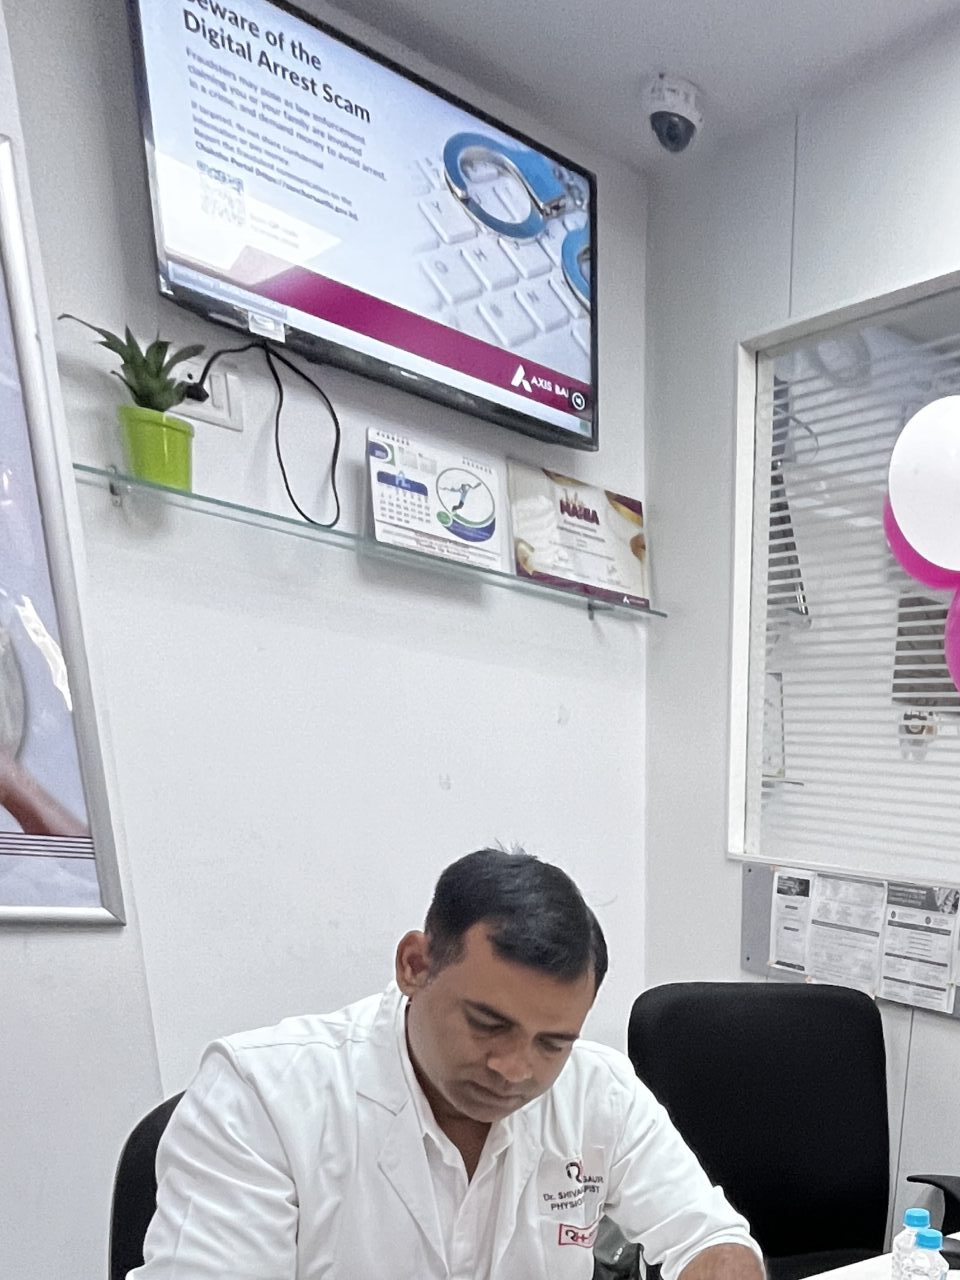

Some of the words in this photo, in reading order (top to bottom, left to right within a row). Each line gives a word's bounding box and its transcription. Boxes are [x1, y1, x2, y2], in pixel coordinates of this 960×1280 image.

[183, 8, 252, 63] Digital
[257, 50, 318, 97] Arrest
[322, 83, 371, 124] Scam
[187, 0, 260, 38] eware
[265, 31, 285, 51] of
[290, 40, 322, 71] the
[531, 375, 553, 392] AXIS
